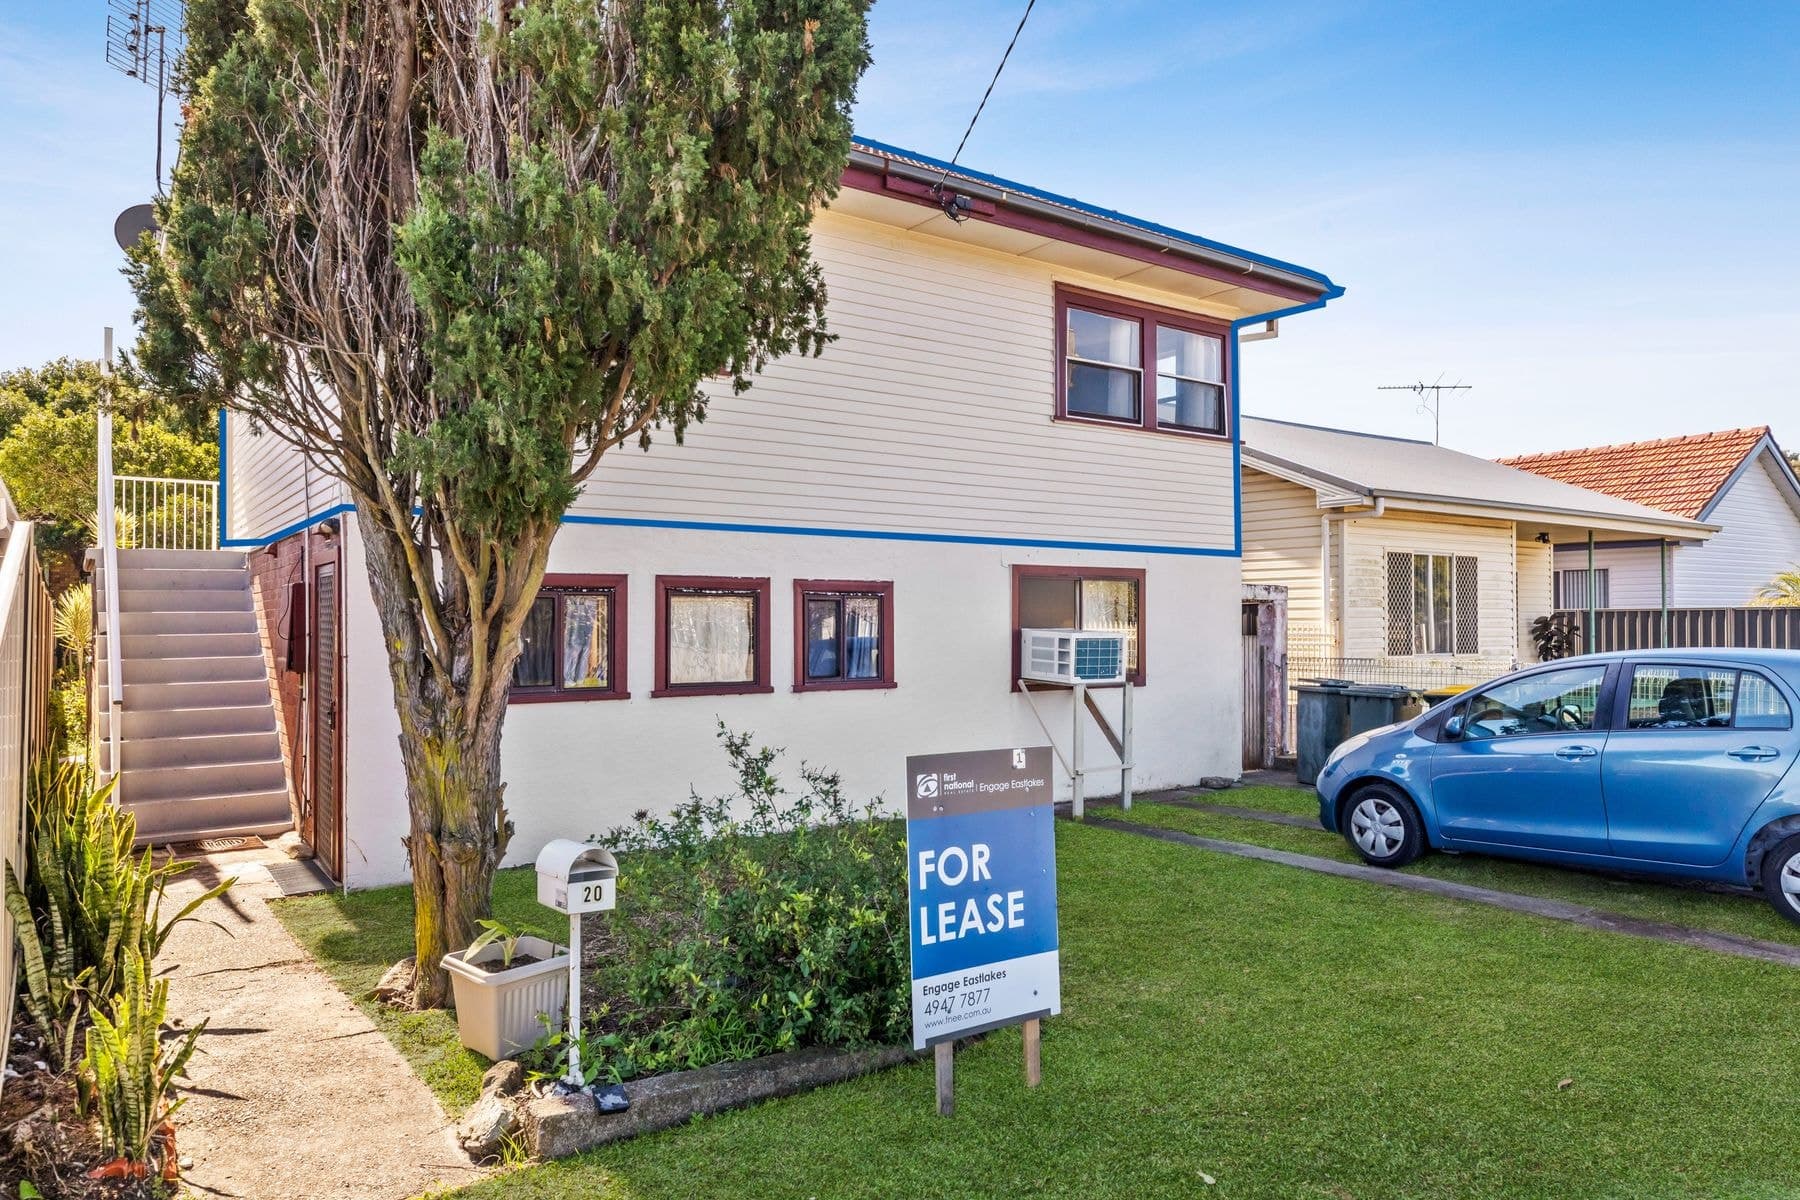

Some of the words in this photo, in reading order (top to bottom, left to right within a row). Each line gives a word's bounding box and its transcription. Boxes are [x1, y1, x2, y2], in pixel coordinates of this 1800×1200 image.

[943, 773, 957, 781] first
[943, 780, 974, 790] national
[979, 782, 1010, 793] Engage
[1011, 778, 1045, 789] Eastlakes
[918, 843, 992, 891] FOR
[583, 885, 602, 903] 20
[920, 890, 1025, 946] LEASE
[922, 979, 961, 996] Engage
[963, 969, 1007, 987] Eastlakes
[924, 996, 955, 1016] 4947
[960, 988, 991, 1008] 7877
[924, 1007, 992, 1029] www.fnee.com.au
